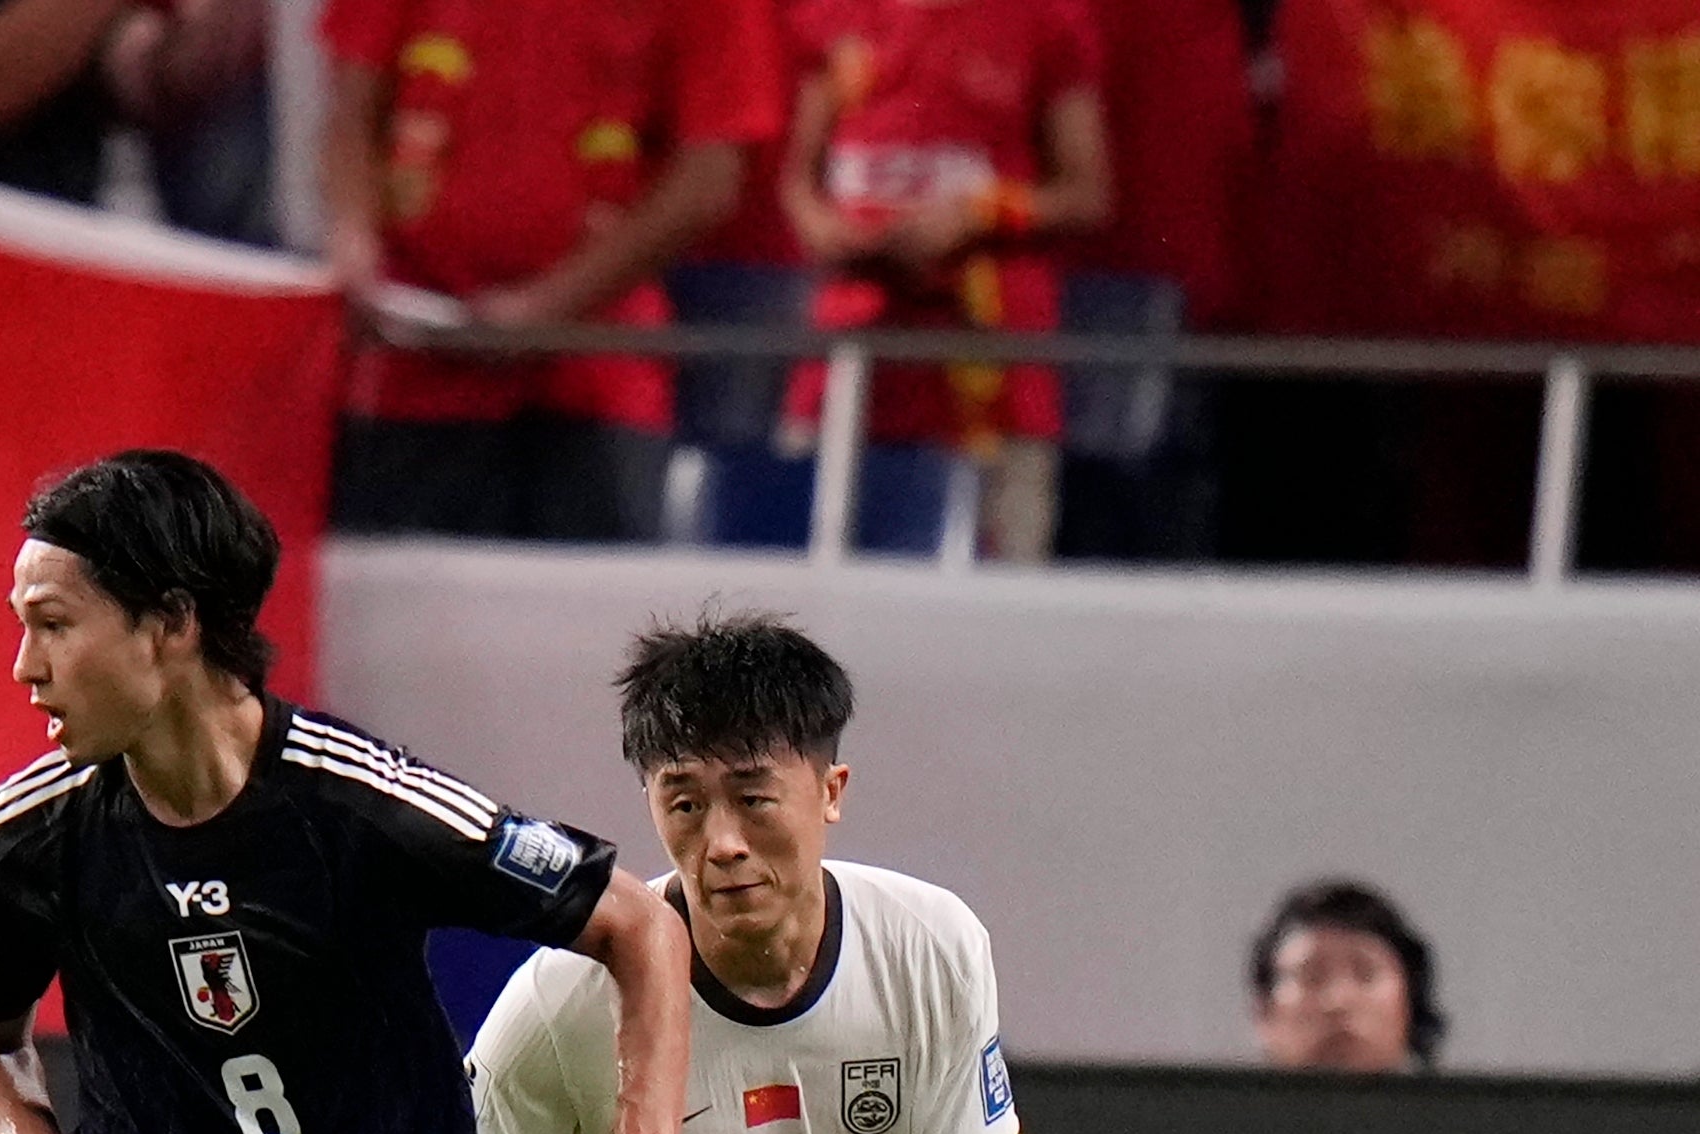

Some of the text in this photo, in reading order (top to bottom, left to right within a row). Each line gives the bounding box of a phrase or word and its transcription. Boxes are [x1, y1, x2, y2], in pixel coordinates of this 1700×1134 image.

[164, 880, 230, 917] Y-3
[188, 938, 225, 951] JAPAN
[847, 1064, 895, 1080] CFA
